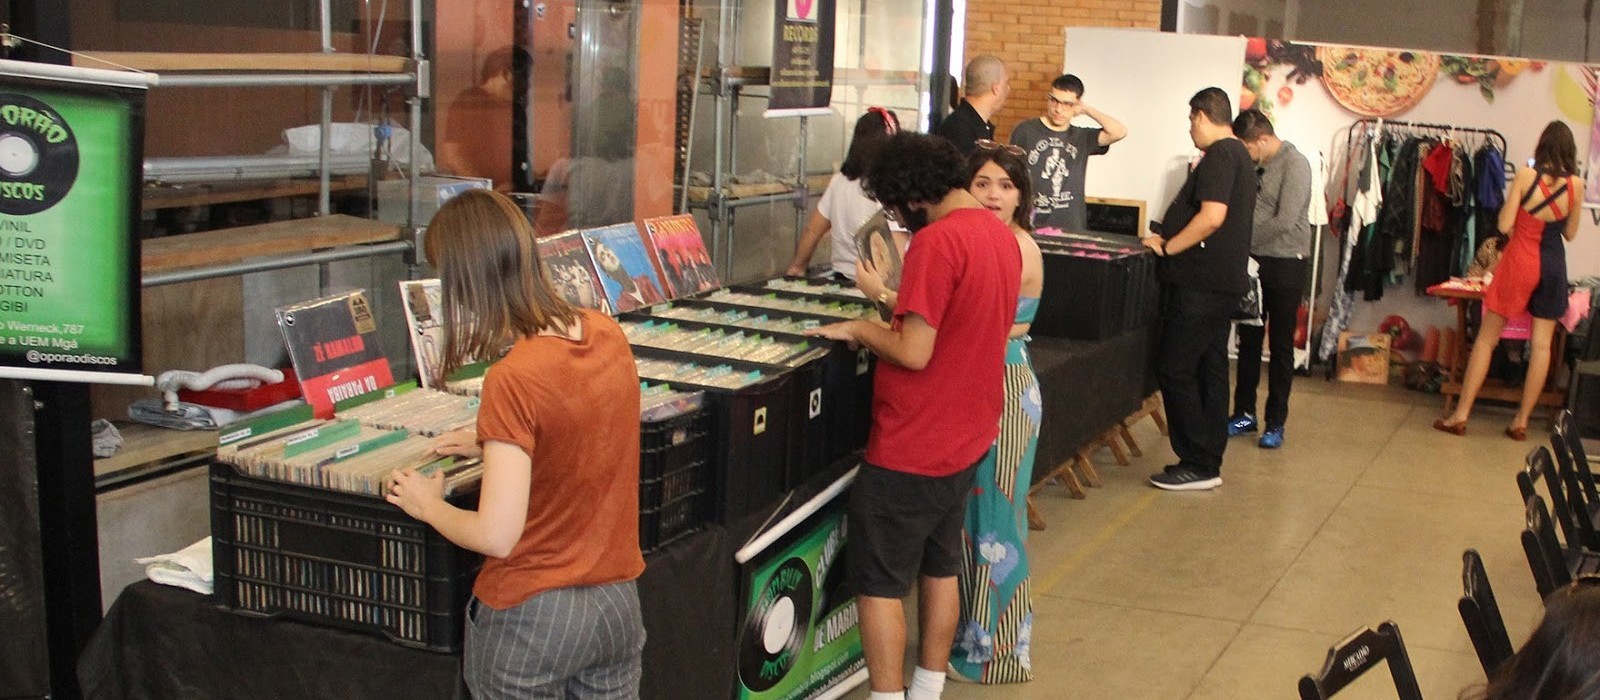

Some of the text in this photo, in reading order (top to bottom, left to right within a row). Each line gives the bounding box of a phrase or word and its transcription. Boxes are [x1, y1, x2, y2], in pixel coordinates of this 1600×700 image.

[0, 104, 69, 144] ORÃO
[0, 182, 45, 201] SCOS
[15, 236, 46, 250] DVD
[0, 300, 28, 312] GIBI
[20, 335, 49, 347] UEM
[26, 350, 118, 366] @oporaodiscos
[826, 601, 860, 644] MARIN
